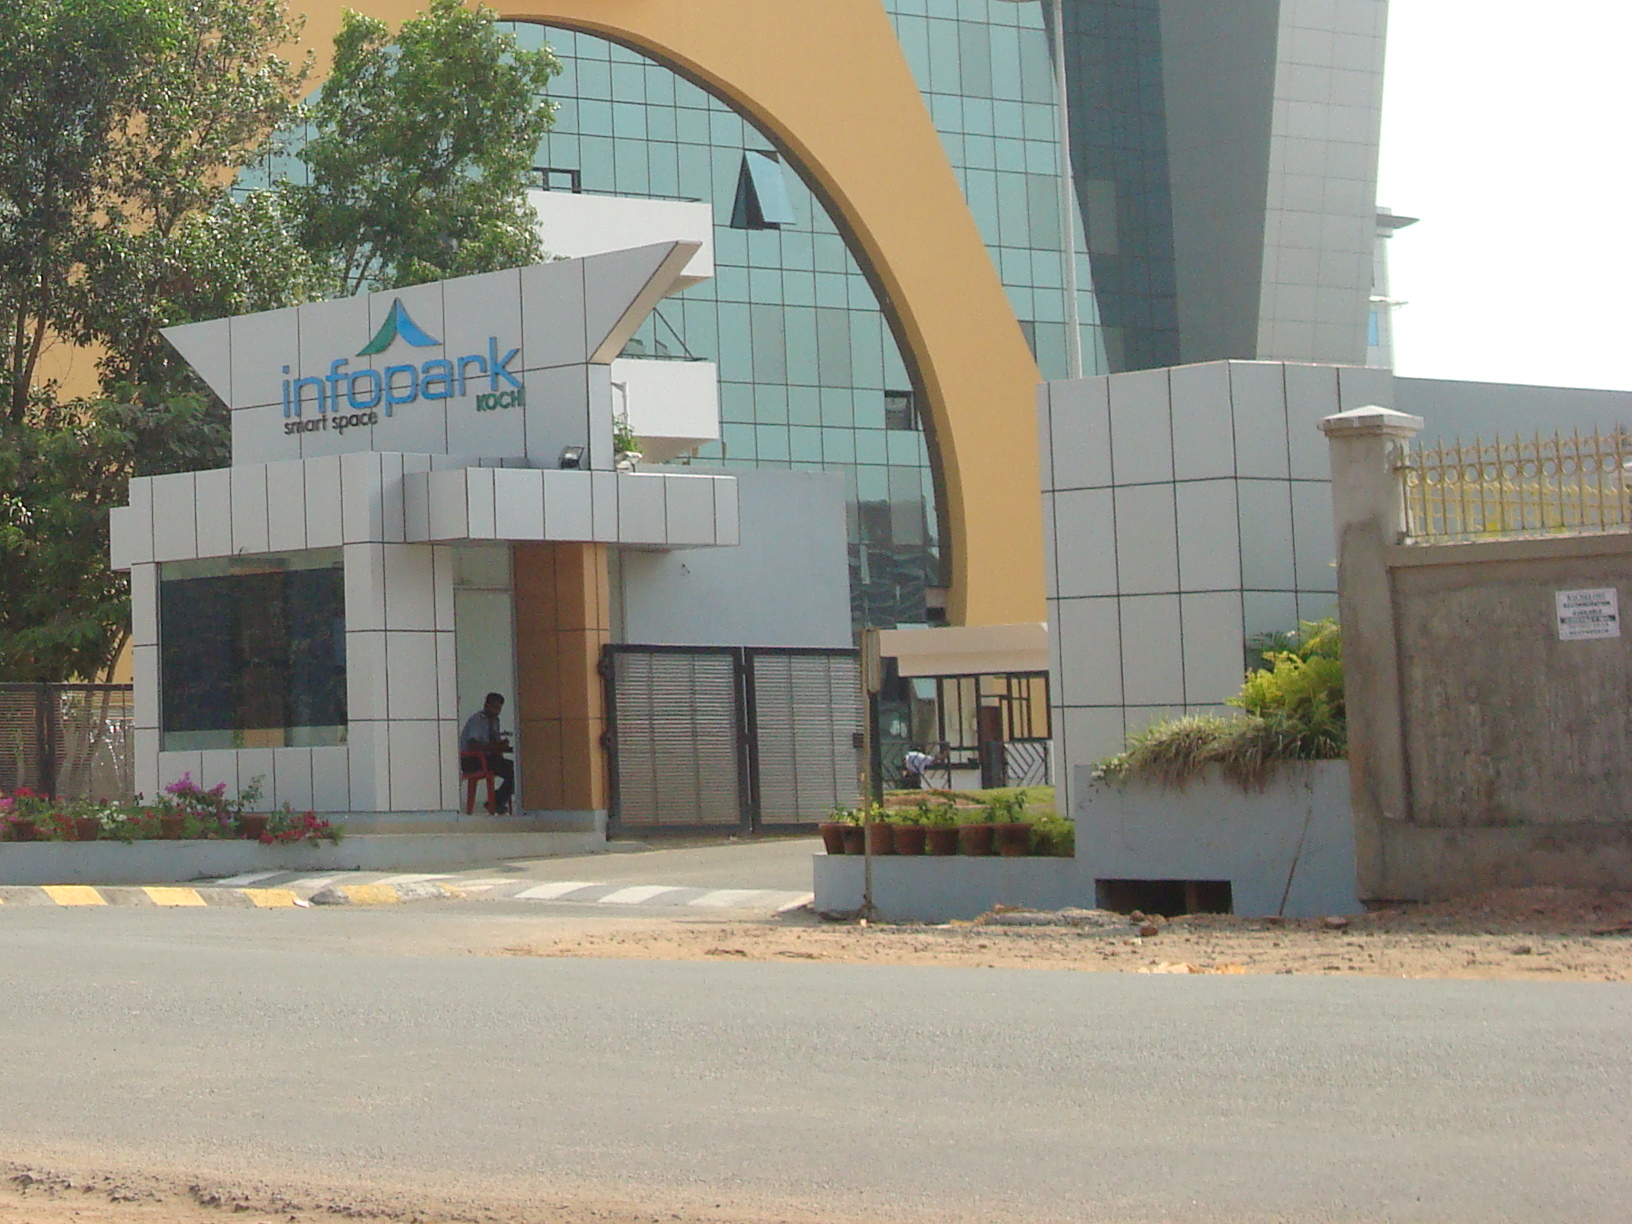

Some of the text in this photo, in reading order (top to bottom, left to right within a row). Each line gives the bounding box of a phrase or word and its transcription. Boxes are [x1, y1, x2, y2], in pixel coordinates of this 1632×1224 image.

[282, 336, 523, 418] infopark
[284, 411, 378, 435] smart space
